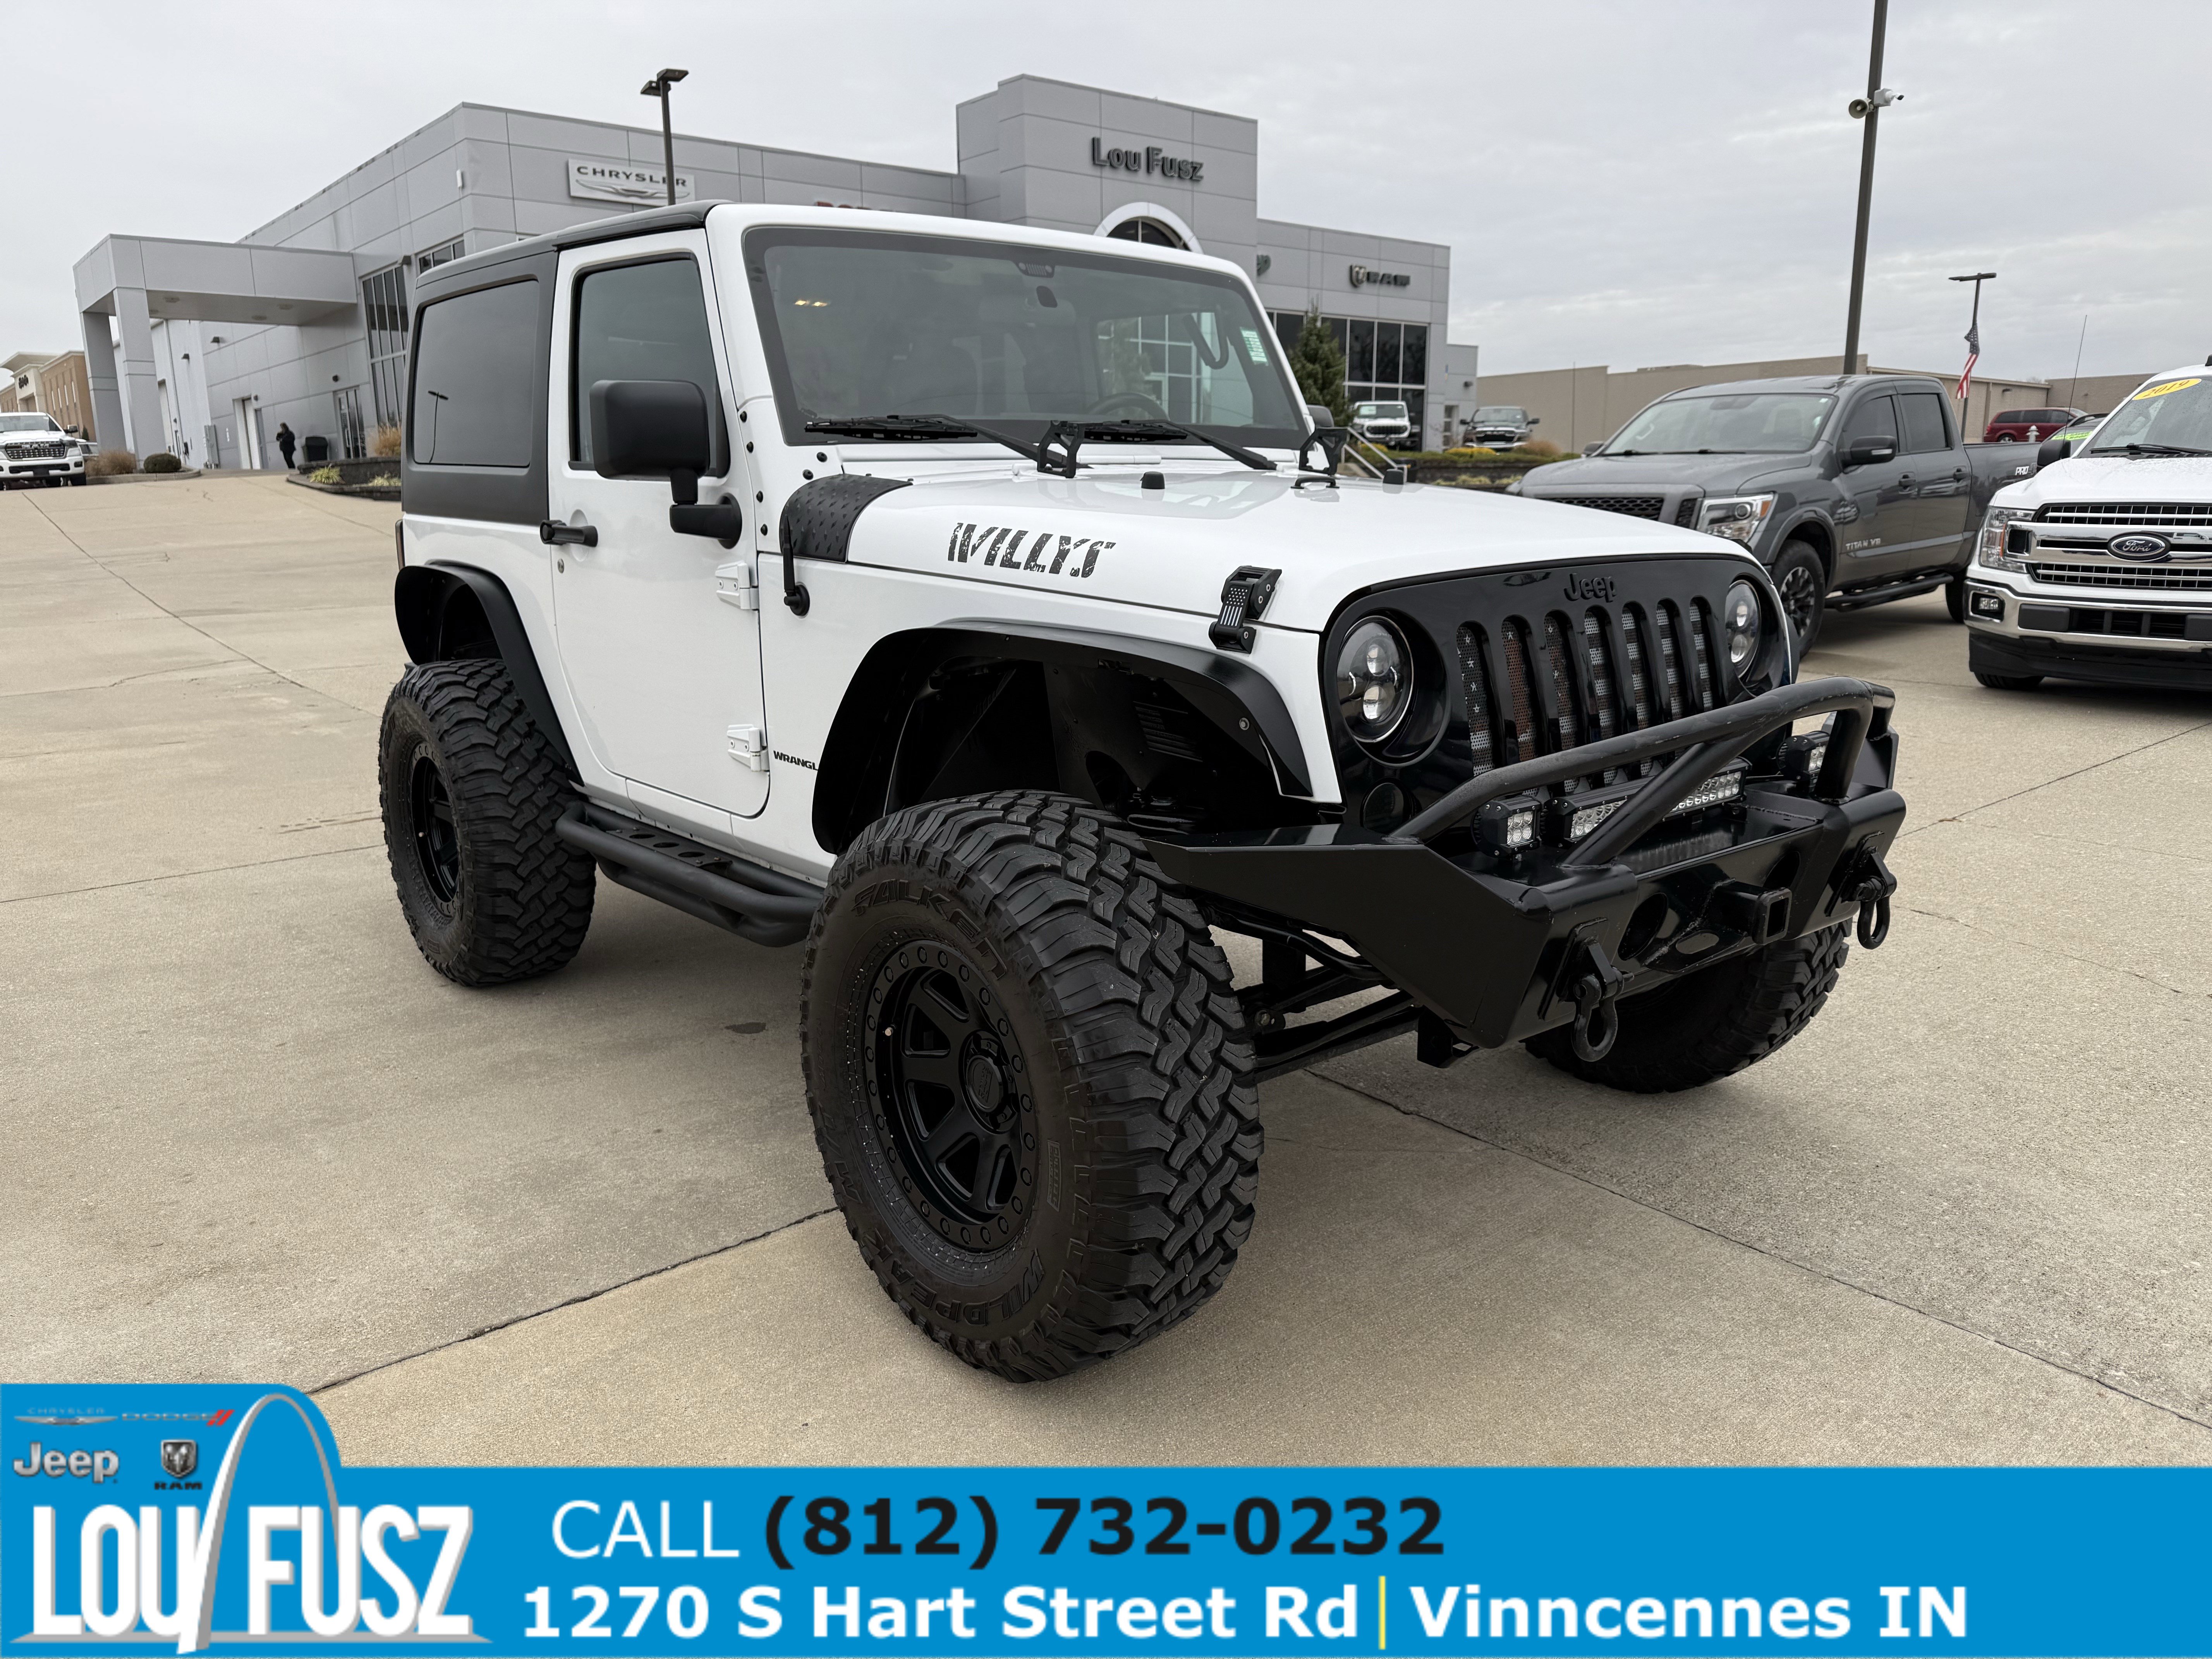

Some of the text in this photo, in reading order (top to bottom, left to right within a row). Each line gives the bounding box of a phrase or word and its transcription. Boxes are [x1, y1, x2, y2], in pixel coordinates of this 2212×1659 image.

[1091, 137, 1204, 181] Lou Fusz
[1367, 271, 1410, 287] RAM
[947, 522, 1116, 578] WILLYS
[2123, 540, 2152, 551] Ford
[1563, 573, 1617, 603] Jeep
[849, 878, 1008, 980] FALKEN
